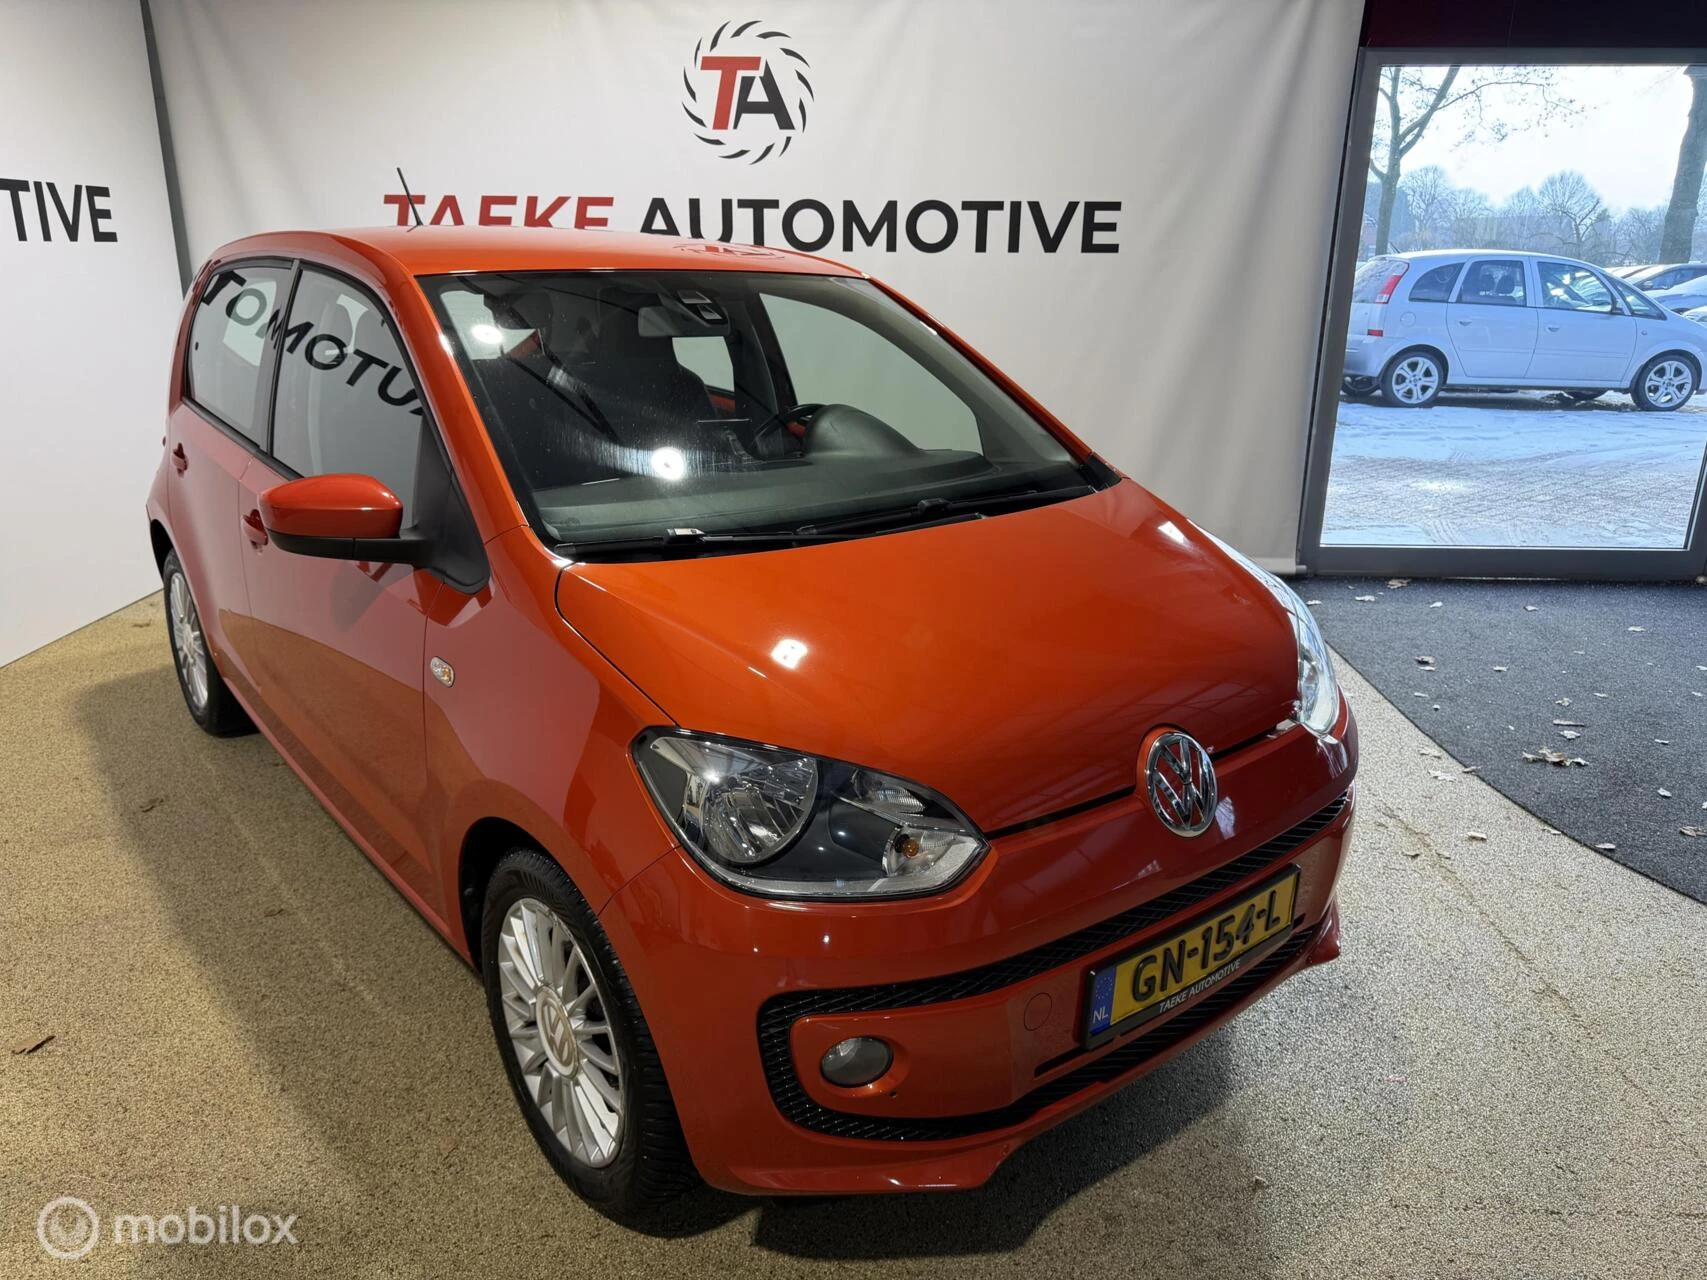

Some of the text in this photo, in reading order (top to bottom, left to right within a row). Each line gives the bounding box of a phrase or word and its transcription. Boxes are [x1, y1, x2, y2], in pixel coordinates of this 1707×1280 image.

[700, 56, 796, 130] TA
[640, 197, 1121, 254] AUTOMOTIVE
[1132, 890, 1280, 1002] GN-154-L
[1159, 958, 1241, 1013] TAEKE AUTOMOTIVE
[1093, 1008, 1109, 1024] NL
